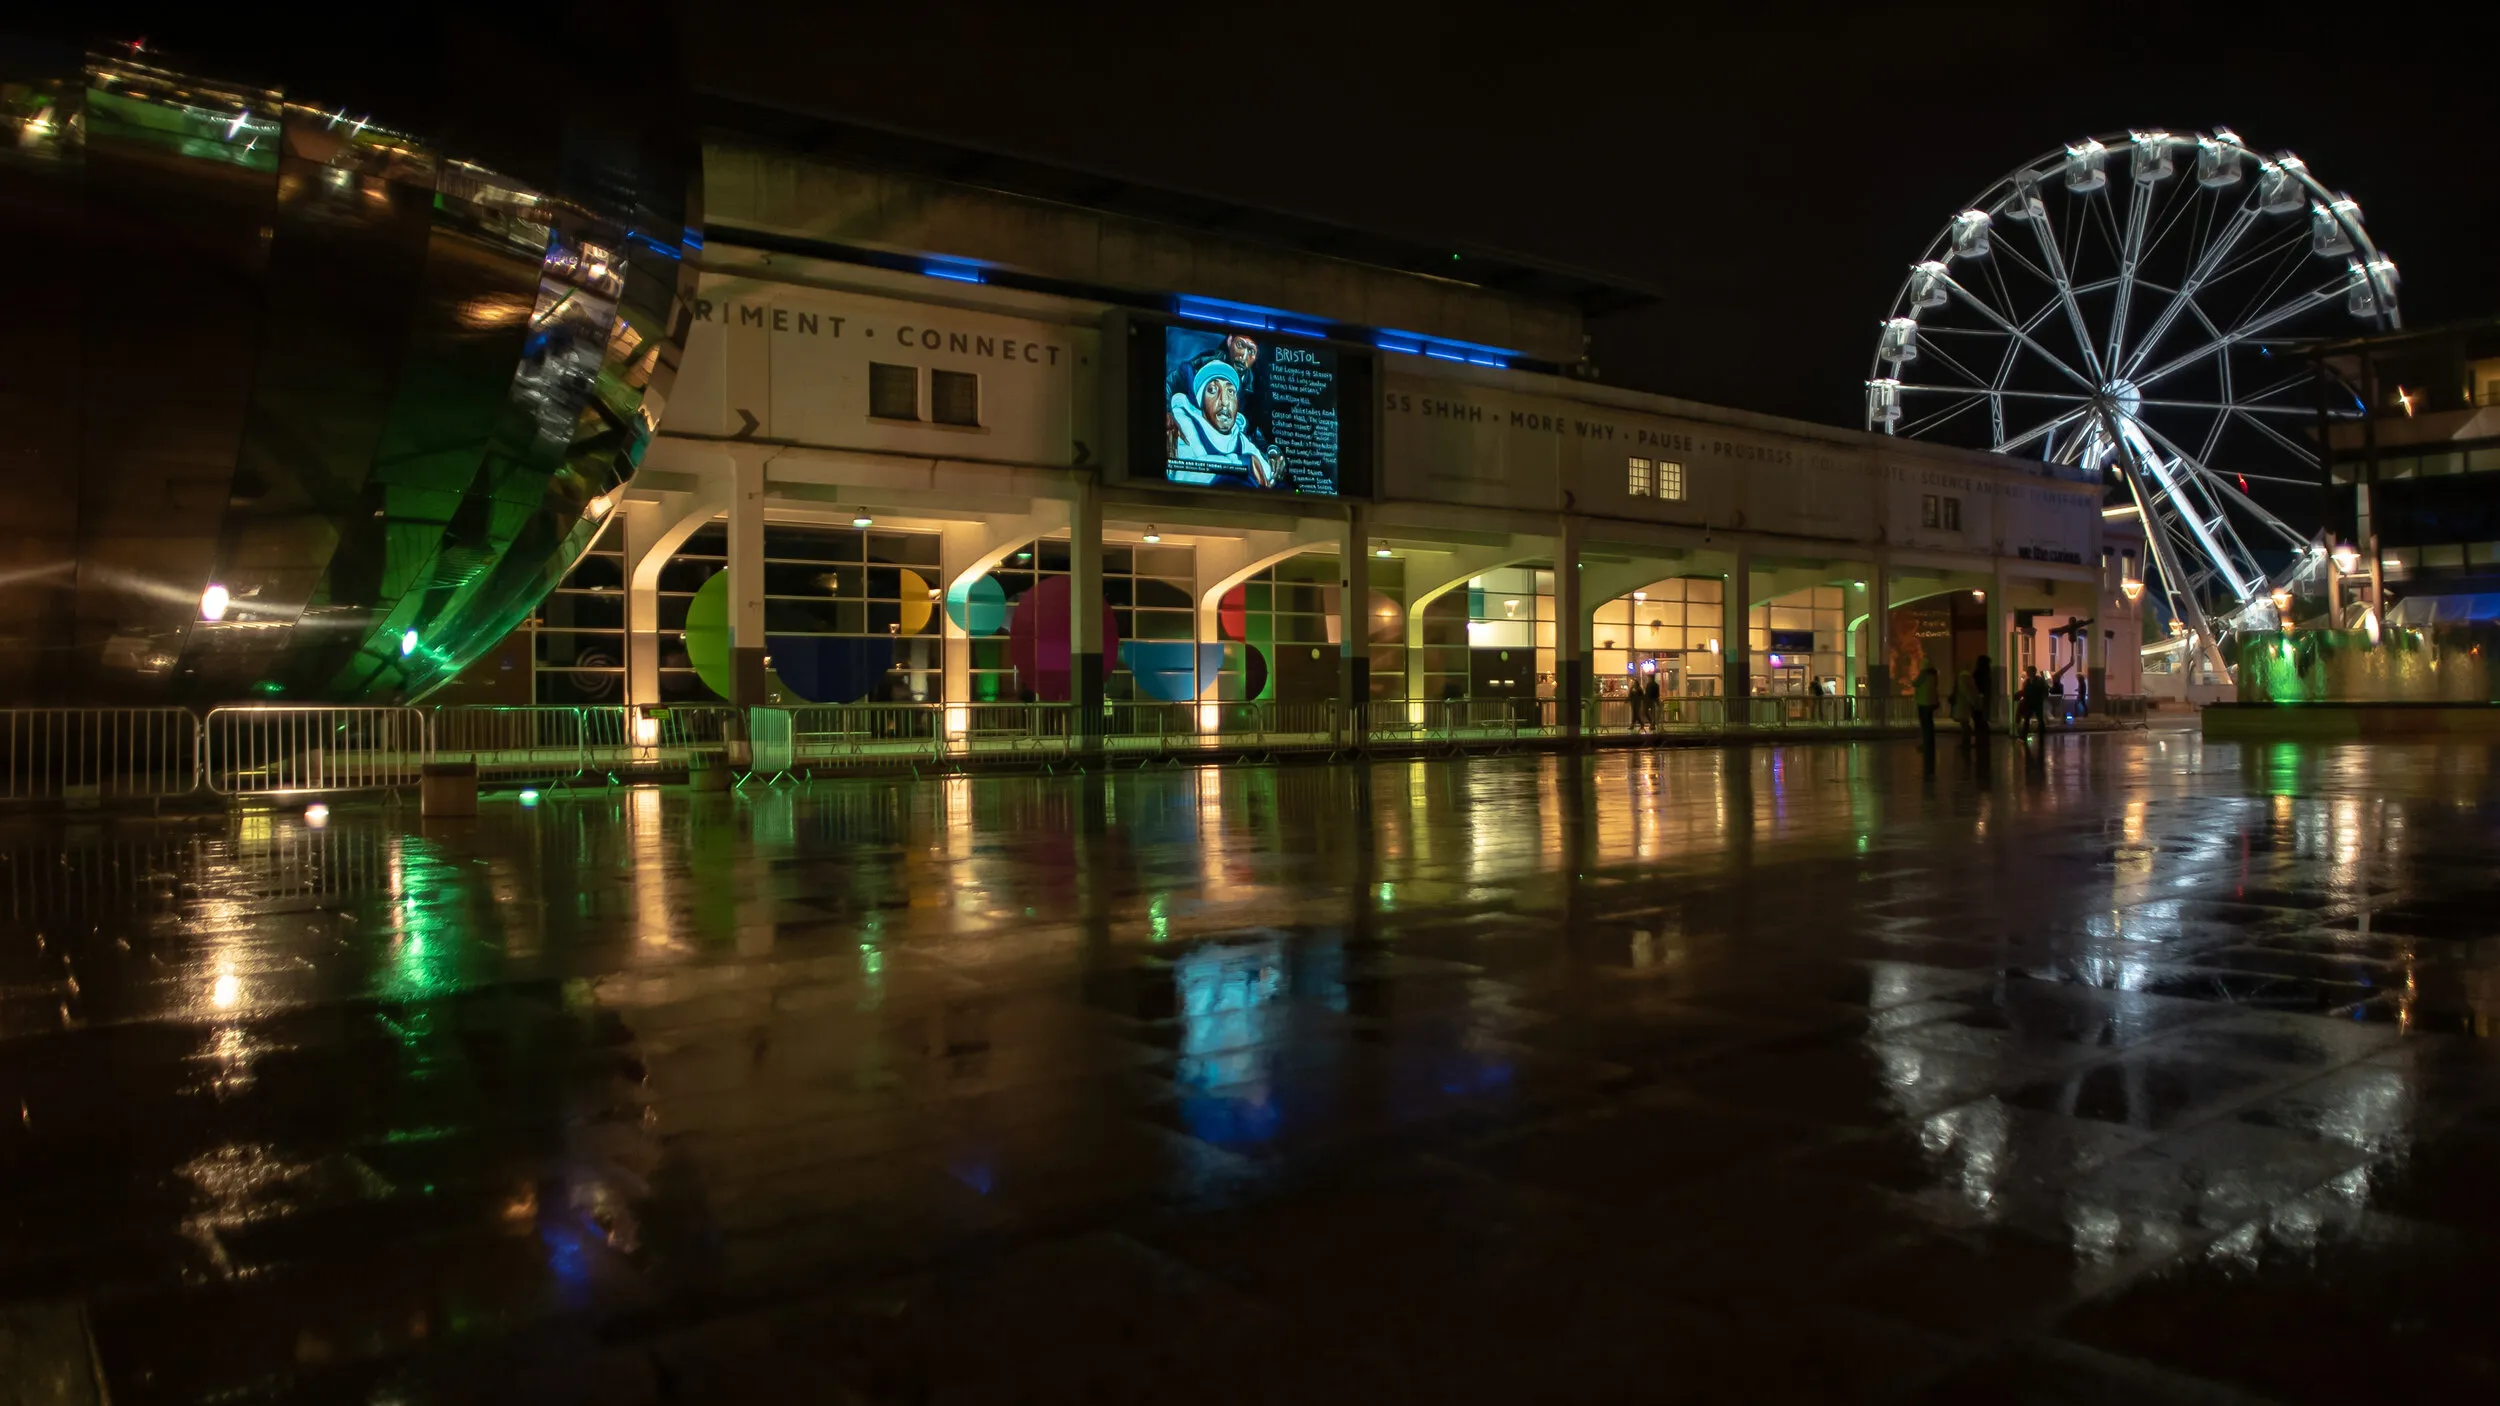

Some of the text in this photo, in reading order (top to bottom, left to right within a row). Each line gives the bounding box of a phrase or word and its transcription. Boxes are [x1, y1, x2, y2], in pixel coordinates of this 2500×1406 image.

[694, 299, 1060, 366] RIMENT CONNECT
[1275, 347, 1320, 364] BRISTOL
[1421, 399, 1482, 423] SHHH
[1510, 410, 1565, 434] MORE
[1575, 420, 1614, 440] WHY
[1638, 430, 1693, 452] PAUSE
[1921, 472, 1971, 492] SCIENCE
